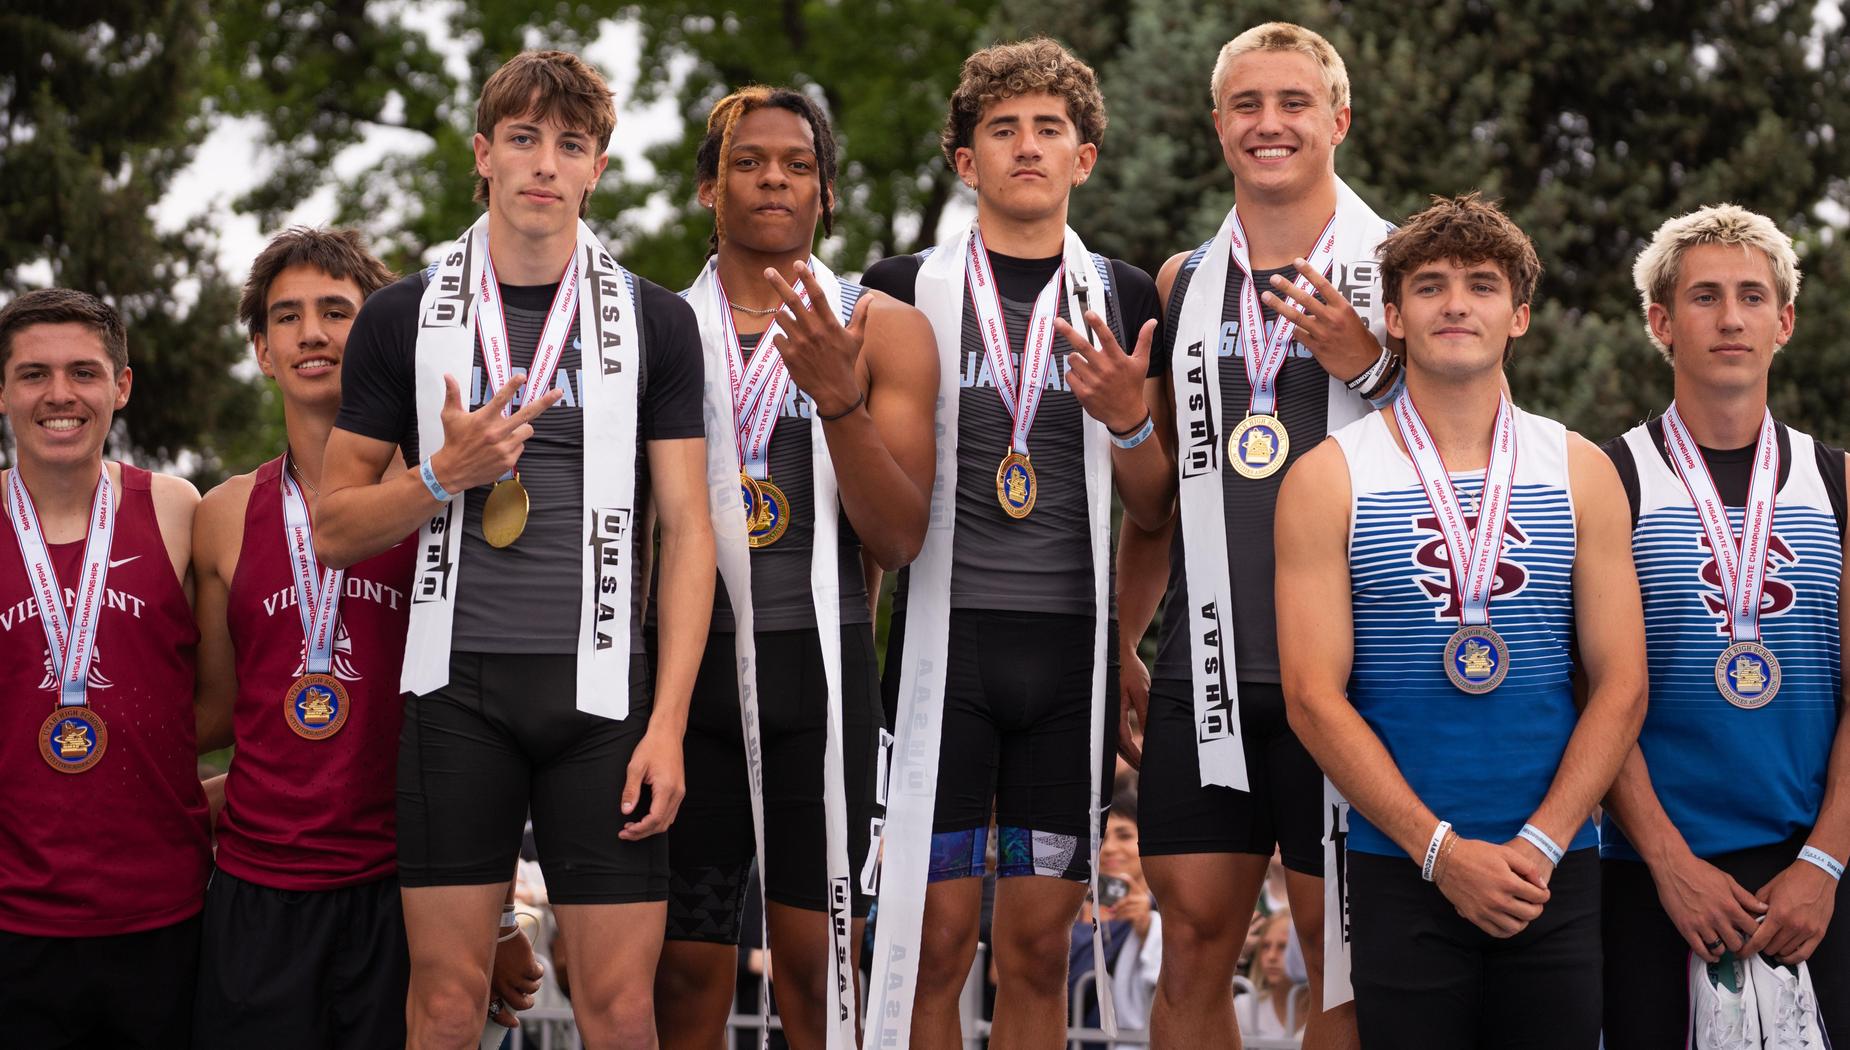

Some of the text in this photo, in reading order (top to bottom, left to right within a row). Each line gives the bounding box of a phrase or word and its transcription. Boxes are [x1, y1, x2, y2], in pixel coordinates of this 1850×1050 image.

[599, 252, 622, 376] UHSAA
[1247, 306, 1255, 328] STATE
[988, 318, 999, 345] UHSAA
[994, 344, 1005, 367] STATE
[1261, 341, 1281, 392] UHSAA STATE
[750, 364, 765, 386] STATE
[1020, 316, 1047, 432] UHSAA STATE CHAMPIONSHIPS
[1188, 340, 1208, 470] UHSAA
[1399, 397, 1425, 450] CHAMPIONSHIPS
[751, 432, 762, 461] UHSAA
[759, 409, 771, 432] STATE
[1668, 415, 1695, 470] CHAMPIONSHIPS
[1763, 447, 1772, 470] UHSAA
[98, 506, 108, 530] UHSAA
[1433, 479, 1448, 505] UHSAA
[1444, 506, 1457, 529] STATE
[1705, 499, 1719, 524] UHSAA
[1714, 526, 1728, 549] STATE
[295, 527, 305, 552] UHSAA
[1473, 484, 1502, 602] UHSAA STATE CHAMPIONSHIPS
[1742, 500, 1765, 617] UHSAA STATE CHAMPIONSHIPS
[35, 562, 48, 589] UHSAA
[43, 589, 56, 614] STATE
[299, 554, 310, 579] STATE
[596, 515, 620, 650] UHSAA
[71, 562, 99, 682] UHSAA STATE CHAMPIONSHIPS
[317, 595, 332, 650] UHSAA STATE
[1201, 601, 1222, 734] UHSAA
[1719, 645, 1777, 671] UTAH HIGH SCHOOL
[1430, 841, 1438, 854] AM
[835, 885, 849, 1022] UHSAA
